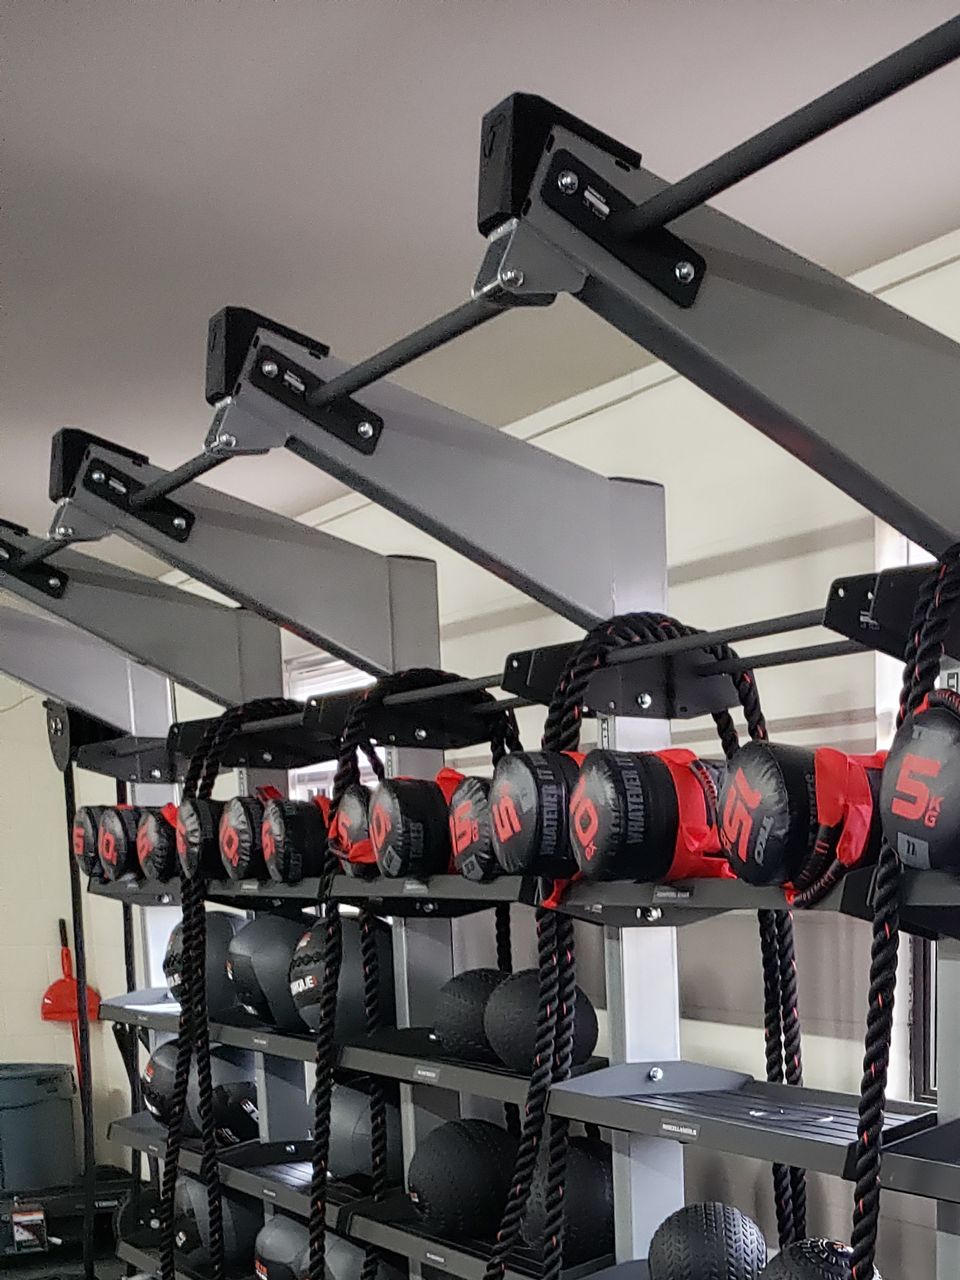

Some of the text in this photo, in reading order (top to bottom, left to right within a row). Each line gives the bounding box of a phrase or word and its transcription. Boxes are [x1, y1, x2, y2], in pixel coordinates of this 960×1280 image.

[570, 775, 599, 847] 10
[620, 769, 645, 844] WHATEVER
[723, 767, 762, 862] 15
[891, 753, 941, 820] 5
[923, 796, 945, 828] KG
